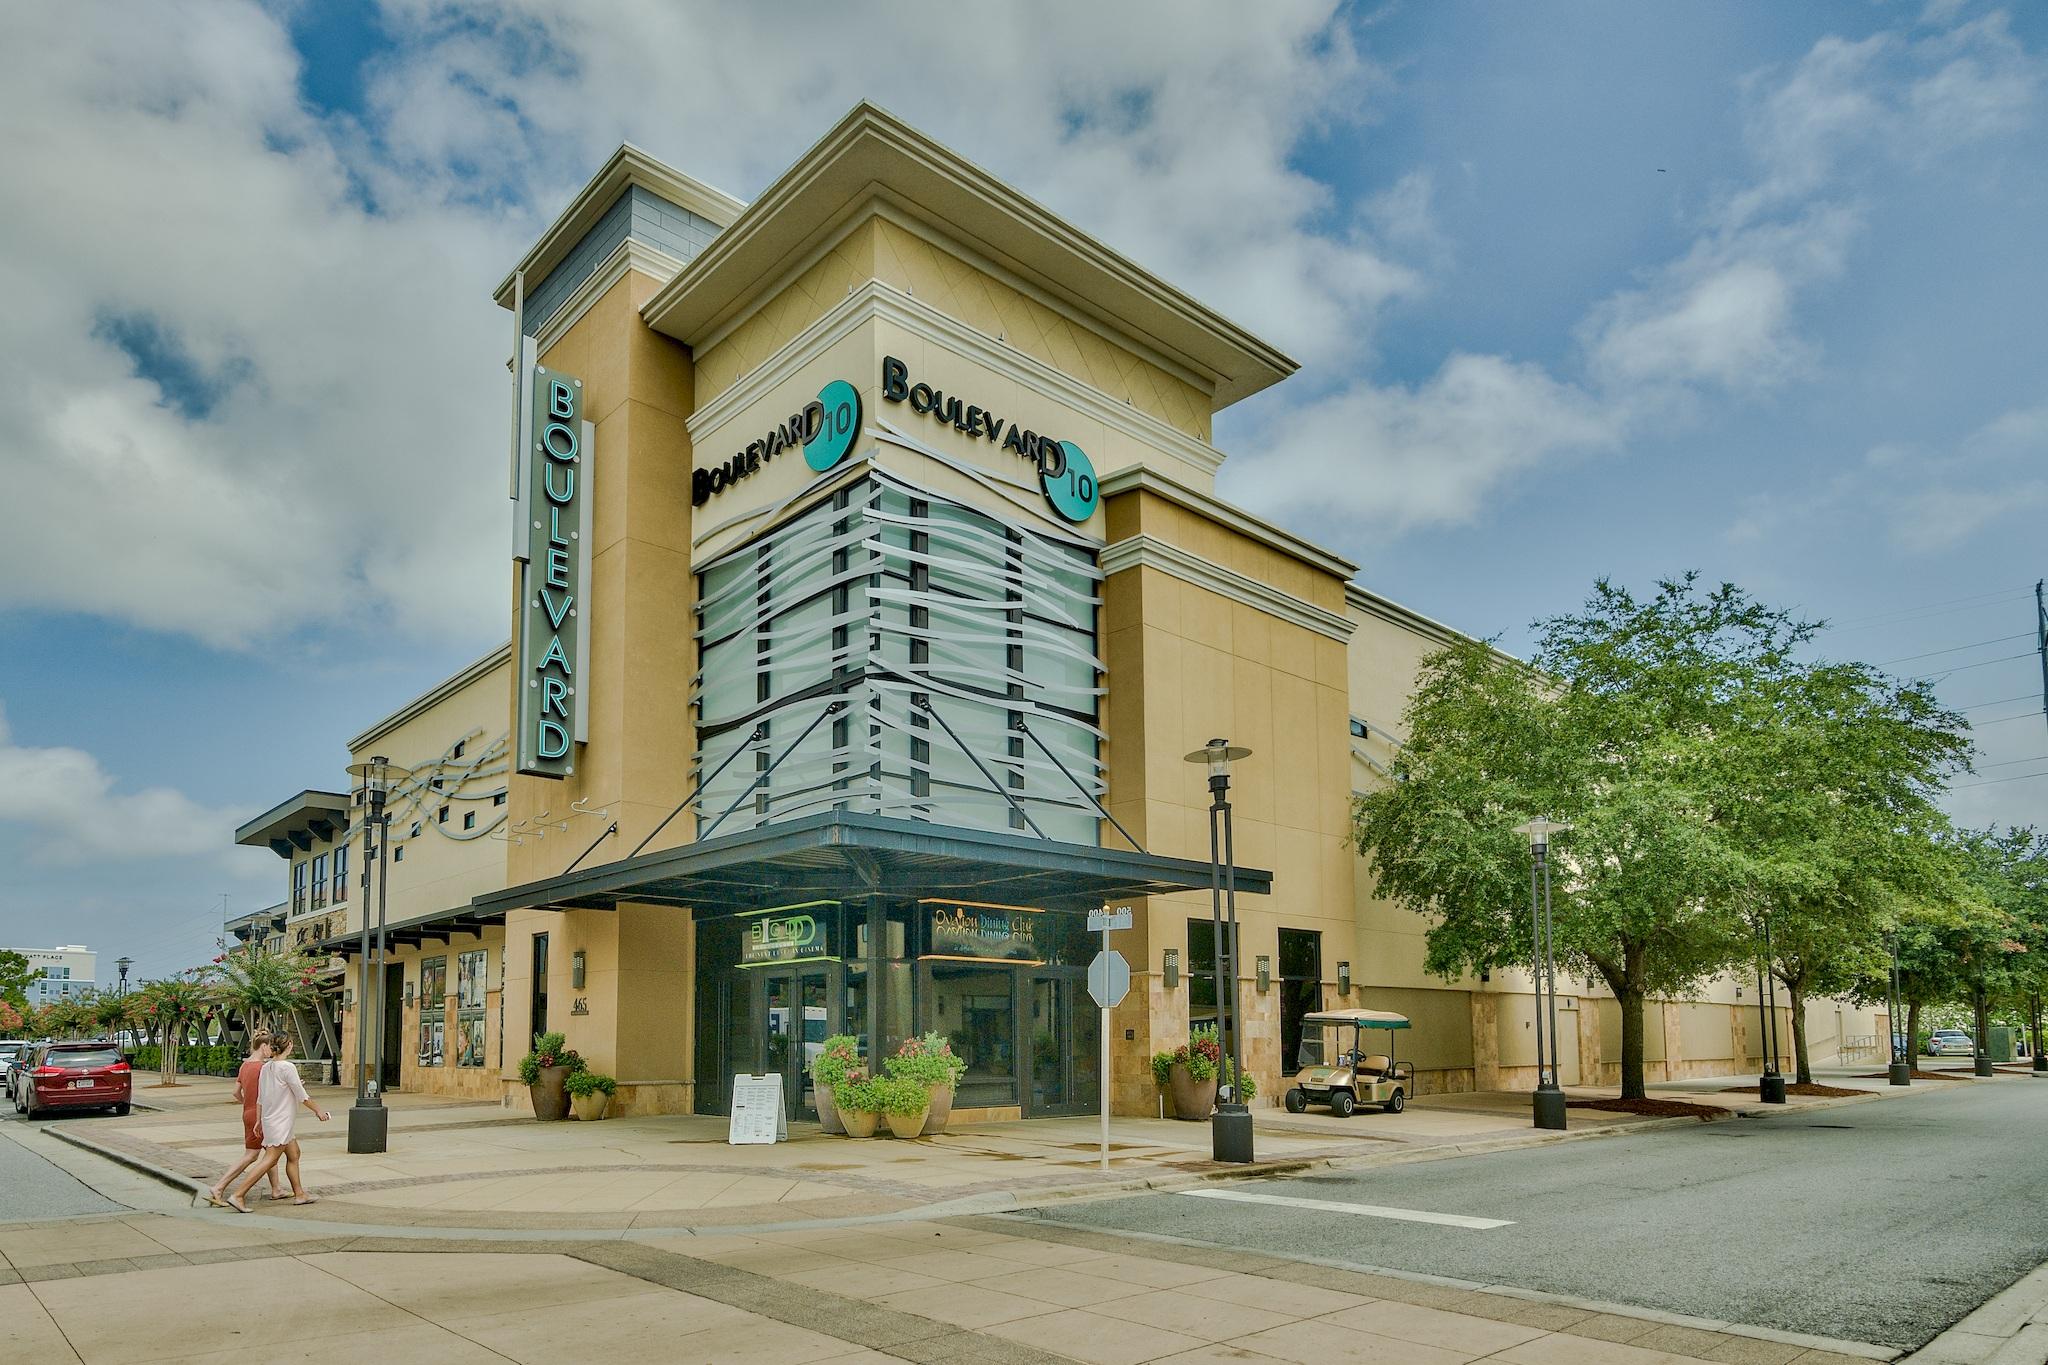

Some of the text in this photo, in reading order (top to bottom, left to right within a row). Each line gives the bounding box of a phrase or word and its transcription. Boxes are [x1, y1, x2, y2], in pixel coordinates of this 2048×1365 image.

[692, 401, 851, 507] BOULEVARD 10
[883, 355, 1094, 504] BOULEVARD 10
[539, 379, 578, 759] BOULEVARD
